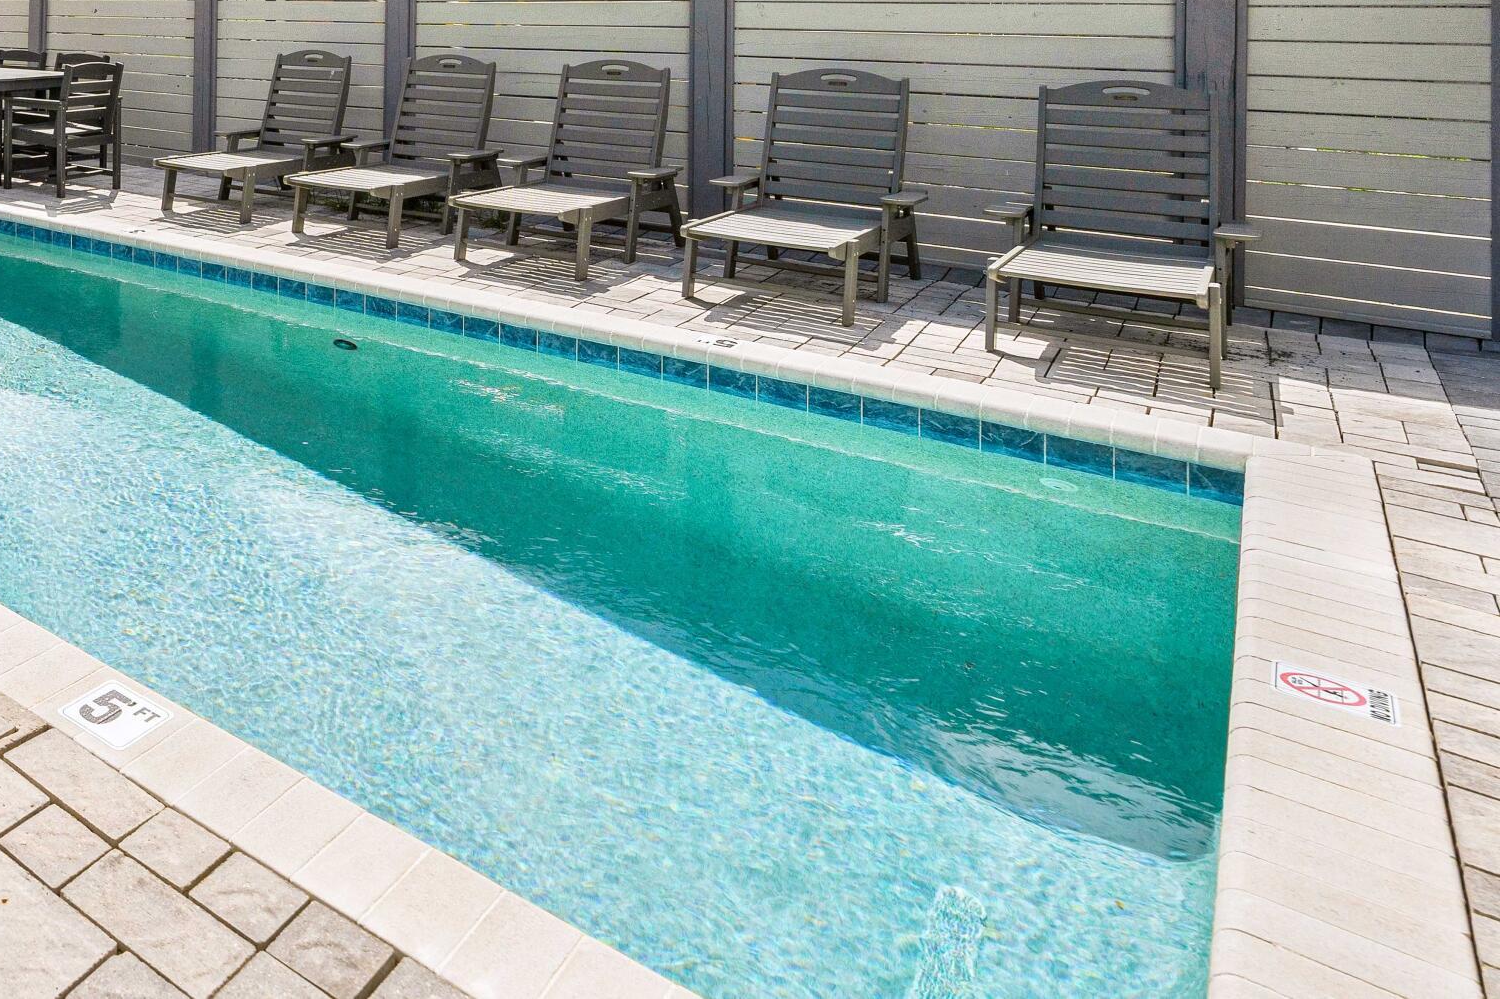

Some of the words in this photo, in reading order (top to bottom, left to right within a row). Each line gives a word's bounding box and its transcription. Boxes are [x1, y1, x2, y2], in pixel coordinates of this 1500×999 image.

[1367, 688, 1390, 712] DIVING
[133, 707, 161, 723] FT
[1369, 709, 1392, 723] NO
